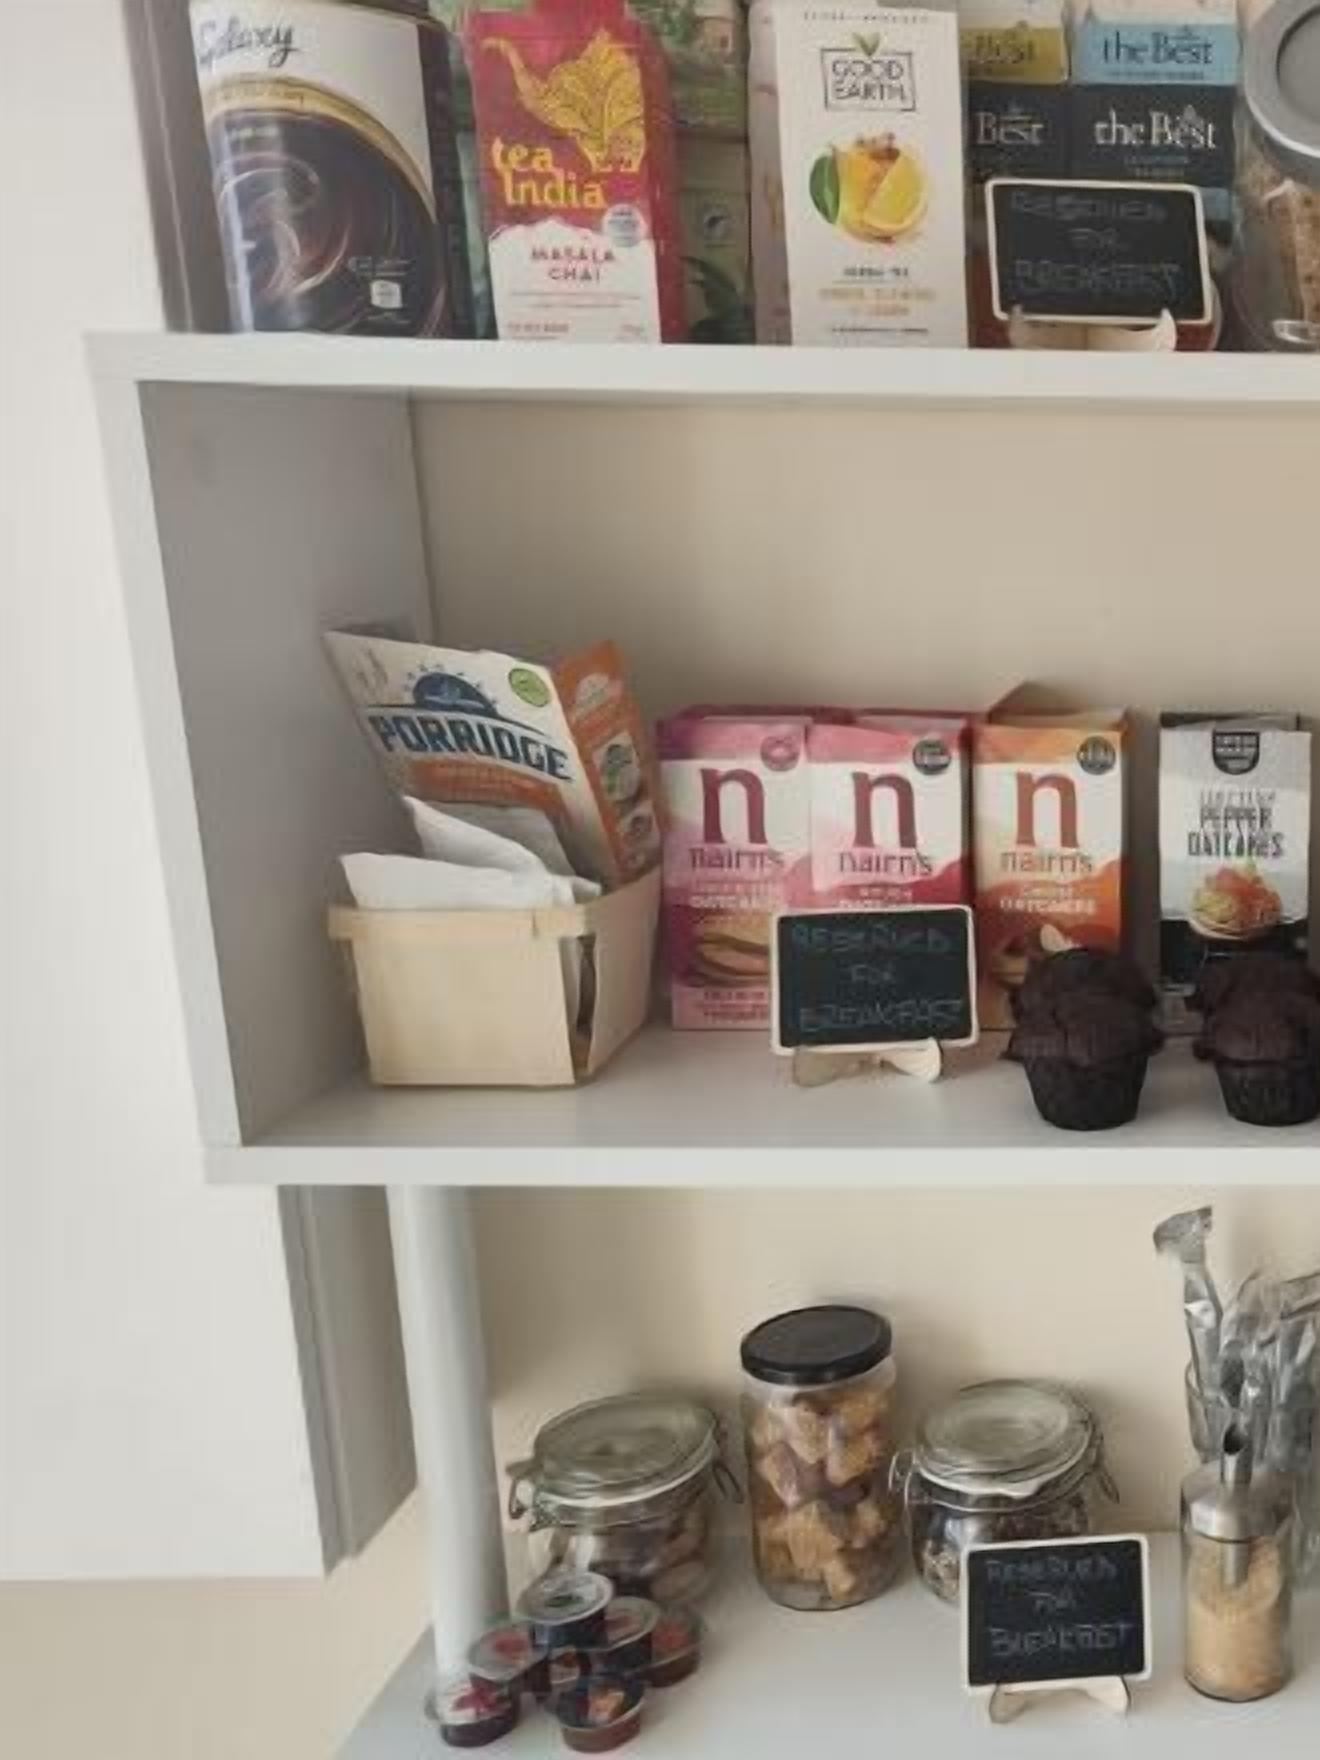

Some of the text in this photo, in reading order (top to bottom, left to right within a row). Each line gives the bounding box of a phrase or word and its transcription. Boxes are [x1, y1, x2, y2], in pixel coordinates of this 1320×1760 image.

[1103, 30, 1214, 65] the Best
[831, 59, 904, 80] GOOD
[832, 80, 906, 101] EARTH
[1094, 106, 1217, 150] the Best
[490, 136, 554, 173] tea
[500, 167, 607, 209] India
[531, 247, 616, 261] MASALA
[547, 268, 601, 281] CHAI
[368, 714, 576, 783] PORRIDGE
[1187, 831, 1285, 857] OATCAKES
